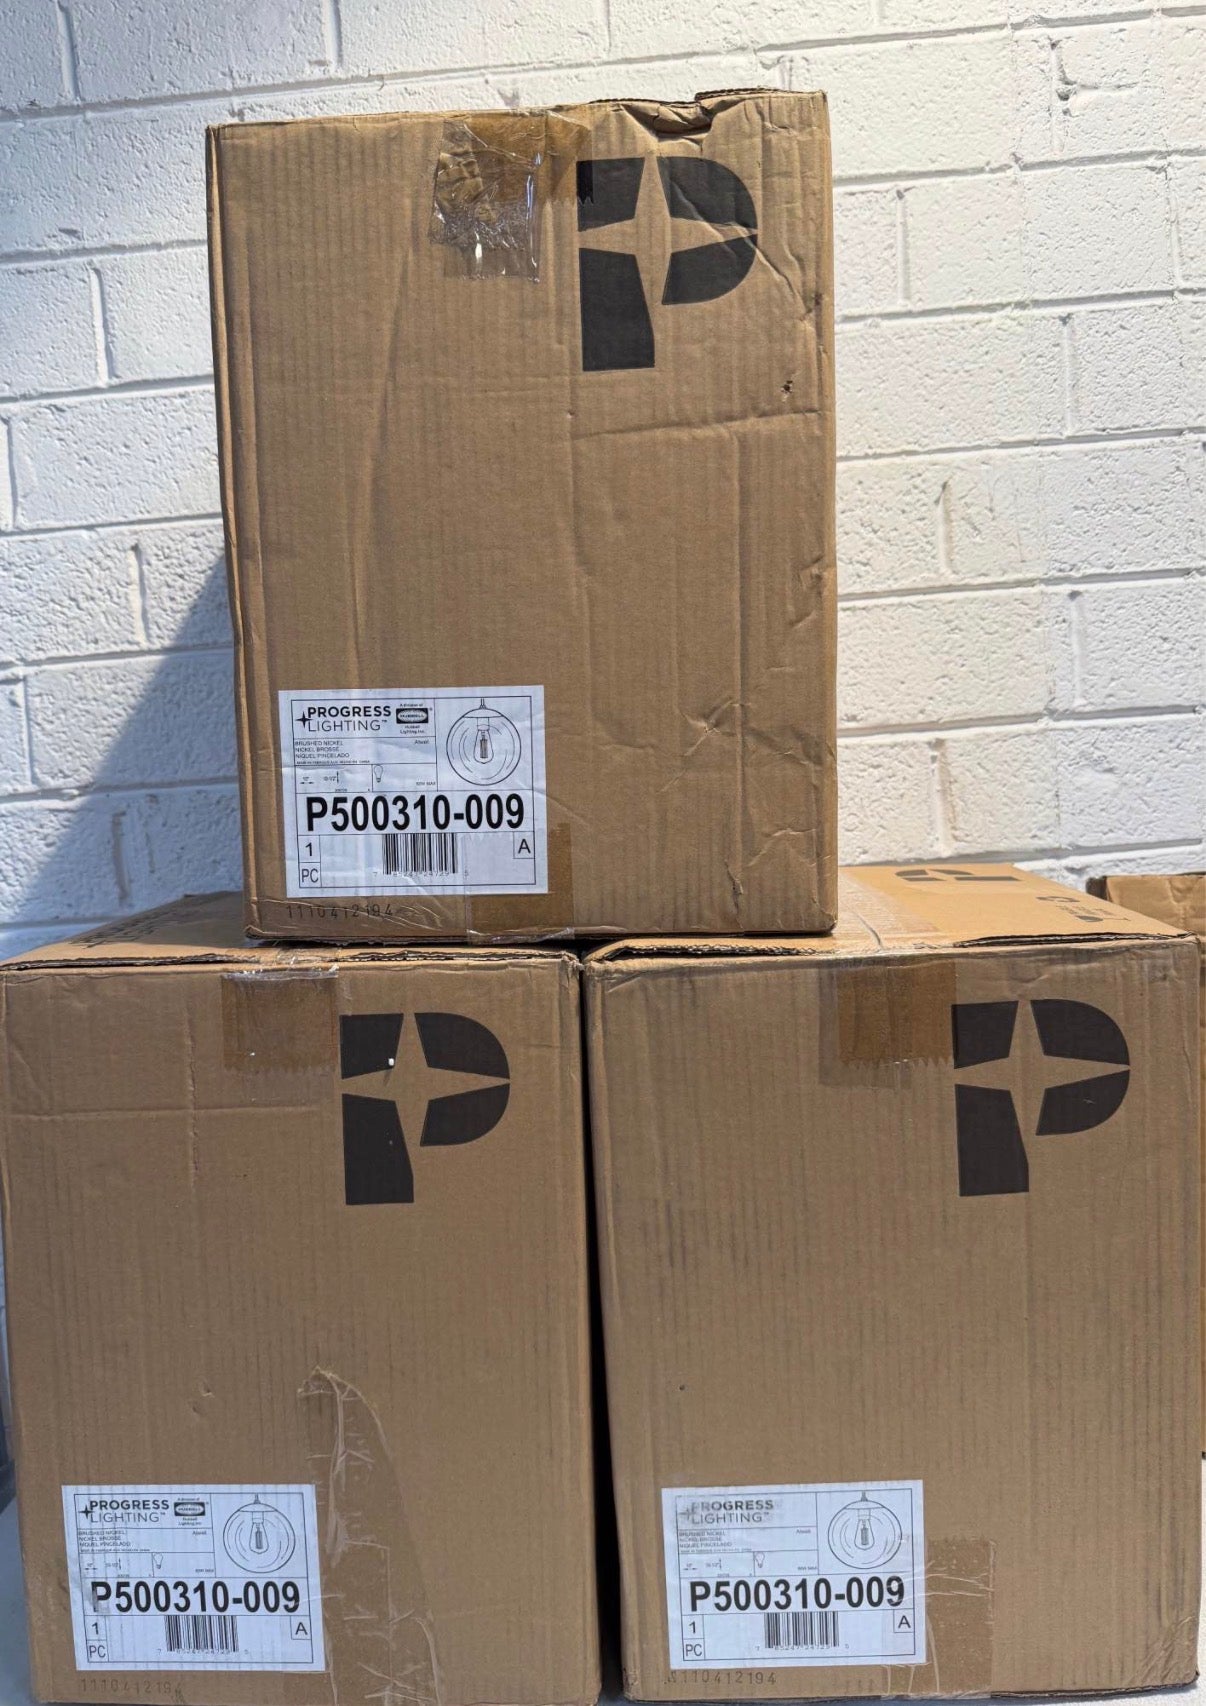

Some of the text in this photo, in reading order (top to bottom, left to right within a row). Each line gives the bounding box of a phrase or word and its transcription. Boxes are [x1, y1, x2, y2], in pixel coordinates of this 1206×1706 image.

[307, 705, 392, 718] PROGRESS
[306, 793, 525, 832] P500310-009
[305, 842, 313, 857] 1
[518, 838, 531, 854] A
[301, 868, 319, 883] PC
[89, 1500, 170, 1511] PROGRESS
[691, 1500, 774, 1513] PROGRESS
[91, 1580, 300, 1613] P500310-009
[690, 1576, 905, 1612] P500310-009
[92, 1622, 99, 1635] 1
[295, 1622, 308, 1635] A
[689, 1622, 696, 1634] 1
[899, 1615, 911, 1629] A
[89, 1646, 106, 1659] PC
[685, 1644, 703, 1657] PC
